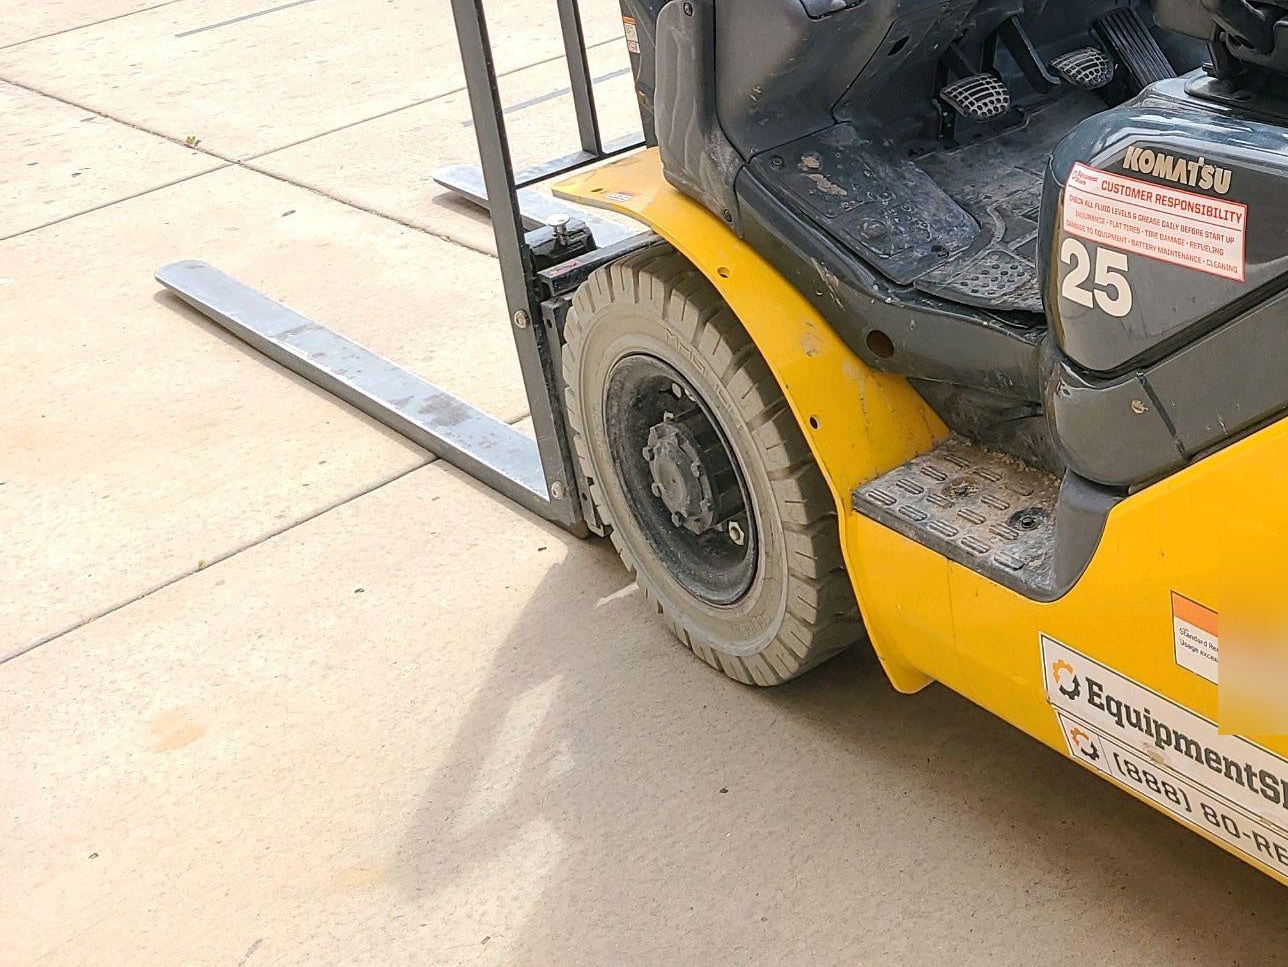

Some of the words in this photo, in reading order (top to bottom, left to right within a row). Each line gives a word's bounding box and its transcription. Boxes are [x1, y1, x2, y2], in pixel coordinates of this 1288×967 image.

[1123, 146, 1232, 194] KOMATSU
[1084, 199, 1094, 209] ALL
[1095, 202, 1110, 214] FLUID
[1112, 207, 1131, 219] LEVELS
[1138, 214, 1160, 225] GREASE
[1161, 220, 1179, 230] DAILY
[1180, 224, 1204, 238] BEFORE
[1204, 230, 1224, 243] START
[1225, 236, 1235, 245] UP
[1101, 180, 1153, 203] CUSTOMER
[1155, 193, 1243, 223] RESPONSIBILITY
[1086, 226, 1094, 234] TO
[1094, 228, 1127, 244] EQUIPMENT
[1131, 239, 1157, 253] BATTERY
[1157, 247, 1204, 264] MAINTENANCE
[1206, 259, 1238, 274] CLEANING
[1109, 220, 1122, 229] FLAT
[1123, 223, 1141, 234] TIRES
[1144, 229, 1159, 240] TIRE
[1160, 233, 1185, 246] DAMAGE
[1189, 240, 1224, 256] REFUELING
[1060, 237, 1133, 318] 25
[1179, 627, 1208, 647] Standard
[1180, 638, 1199, 654] Usage
[1112, 751, 1192, 814] (888)
